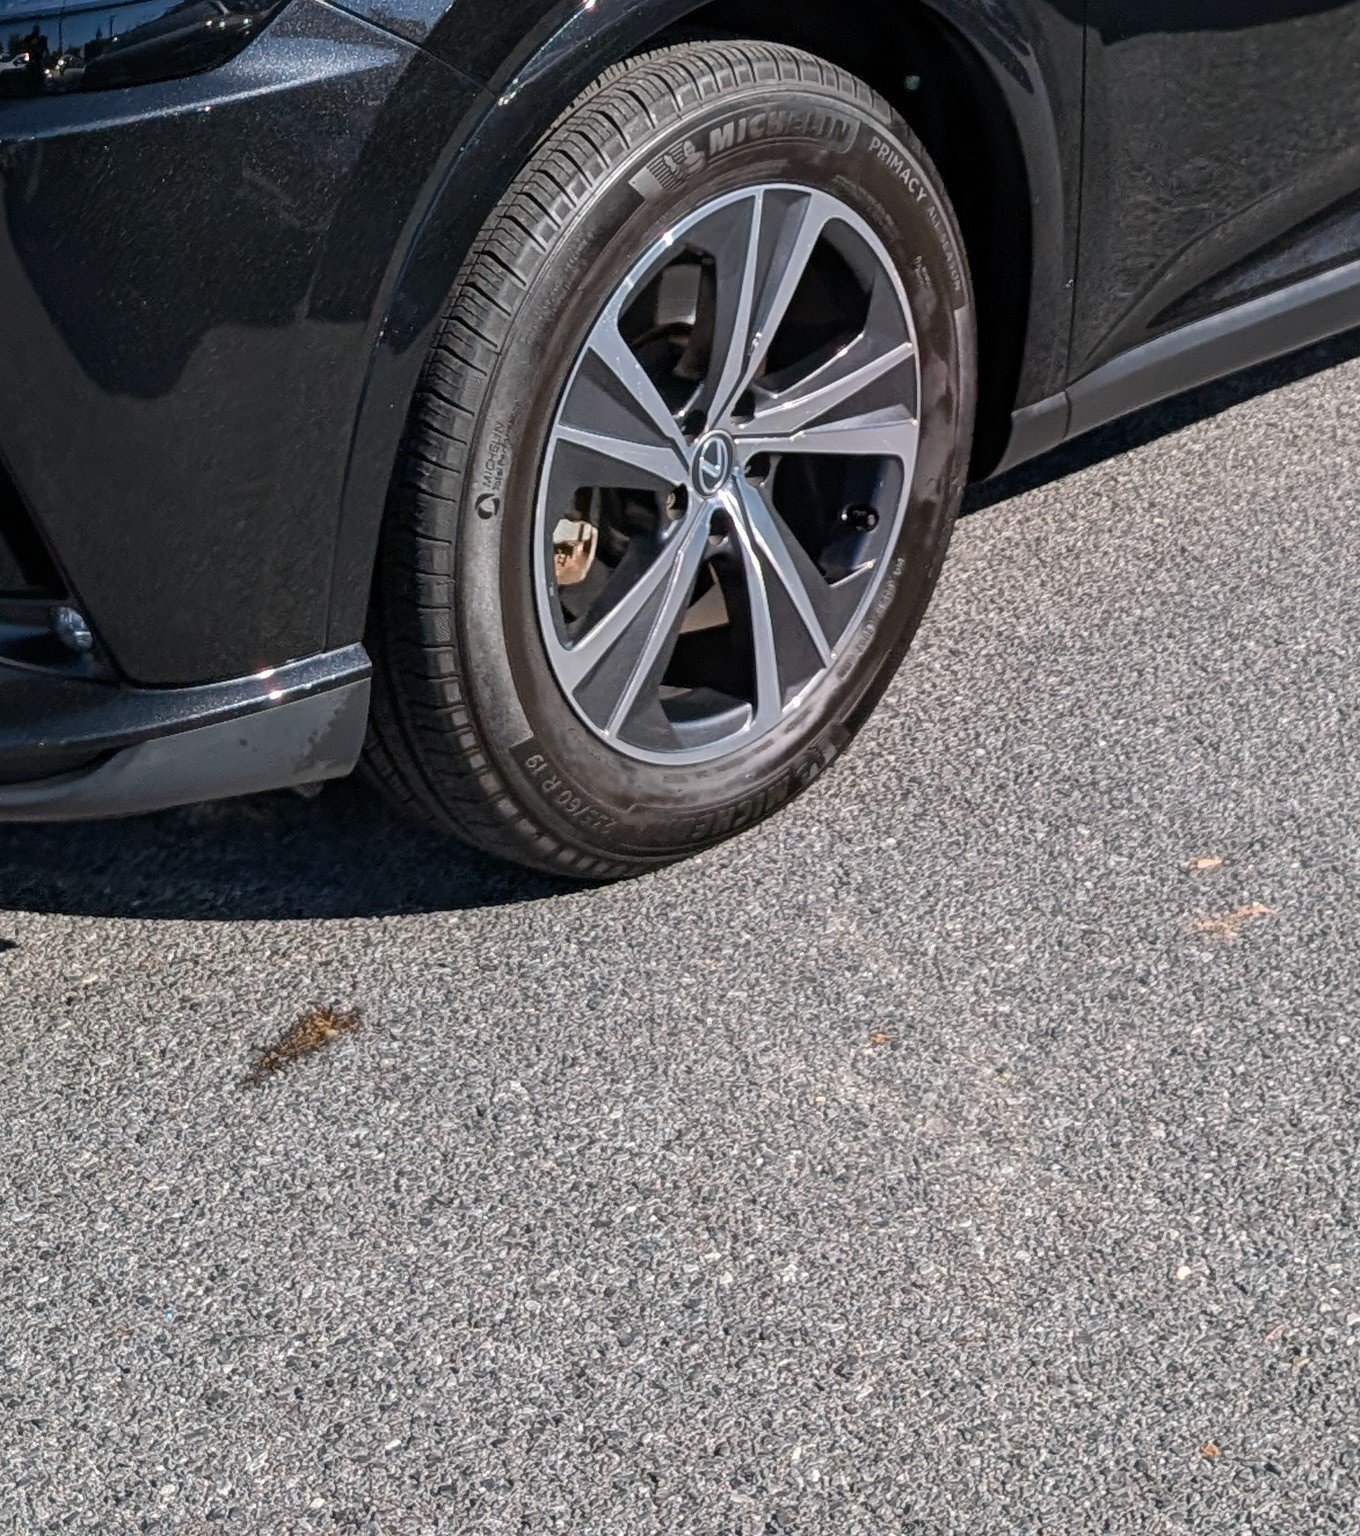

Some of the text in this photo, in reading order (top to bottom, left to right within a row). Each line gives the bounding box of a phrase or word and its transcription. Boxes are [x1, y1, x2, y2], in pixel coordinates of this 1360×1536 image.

[709, 111, 852, 156] MICHELIN
[869, 136, 927, 202] PRIMACY
[482, 421, 505, 488] MICHELIN
